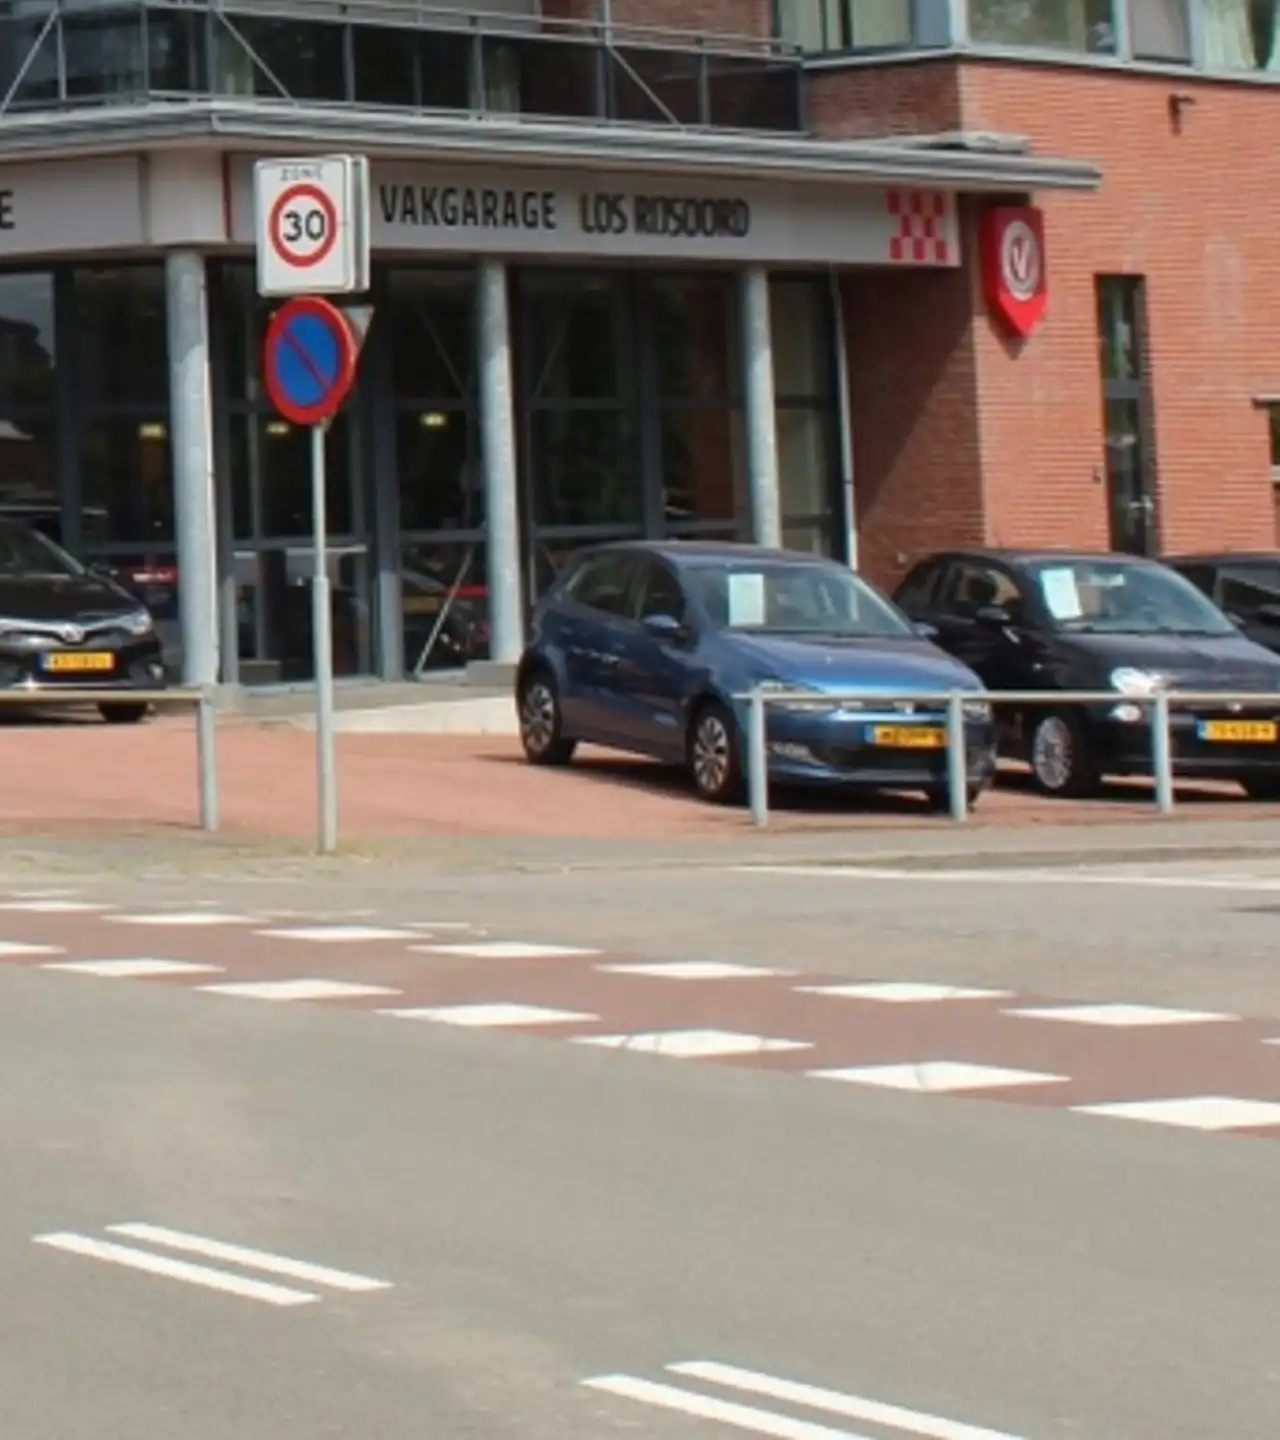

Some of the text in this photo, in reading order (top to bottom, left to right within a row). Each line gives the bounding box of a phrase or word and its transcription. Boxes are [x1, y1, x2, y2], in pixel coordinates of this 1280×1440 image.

[283, 209, 325, 242] 30
[379, 183, 558, 231] VAKGARAGE
[578, 192, 628, 234] LOS
